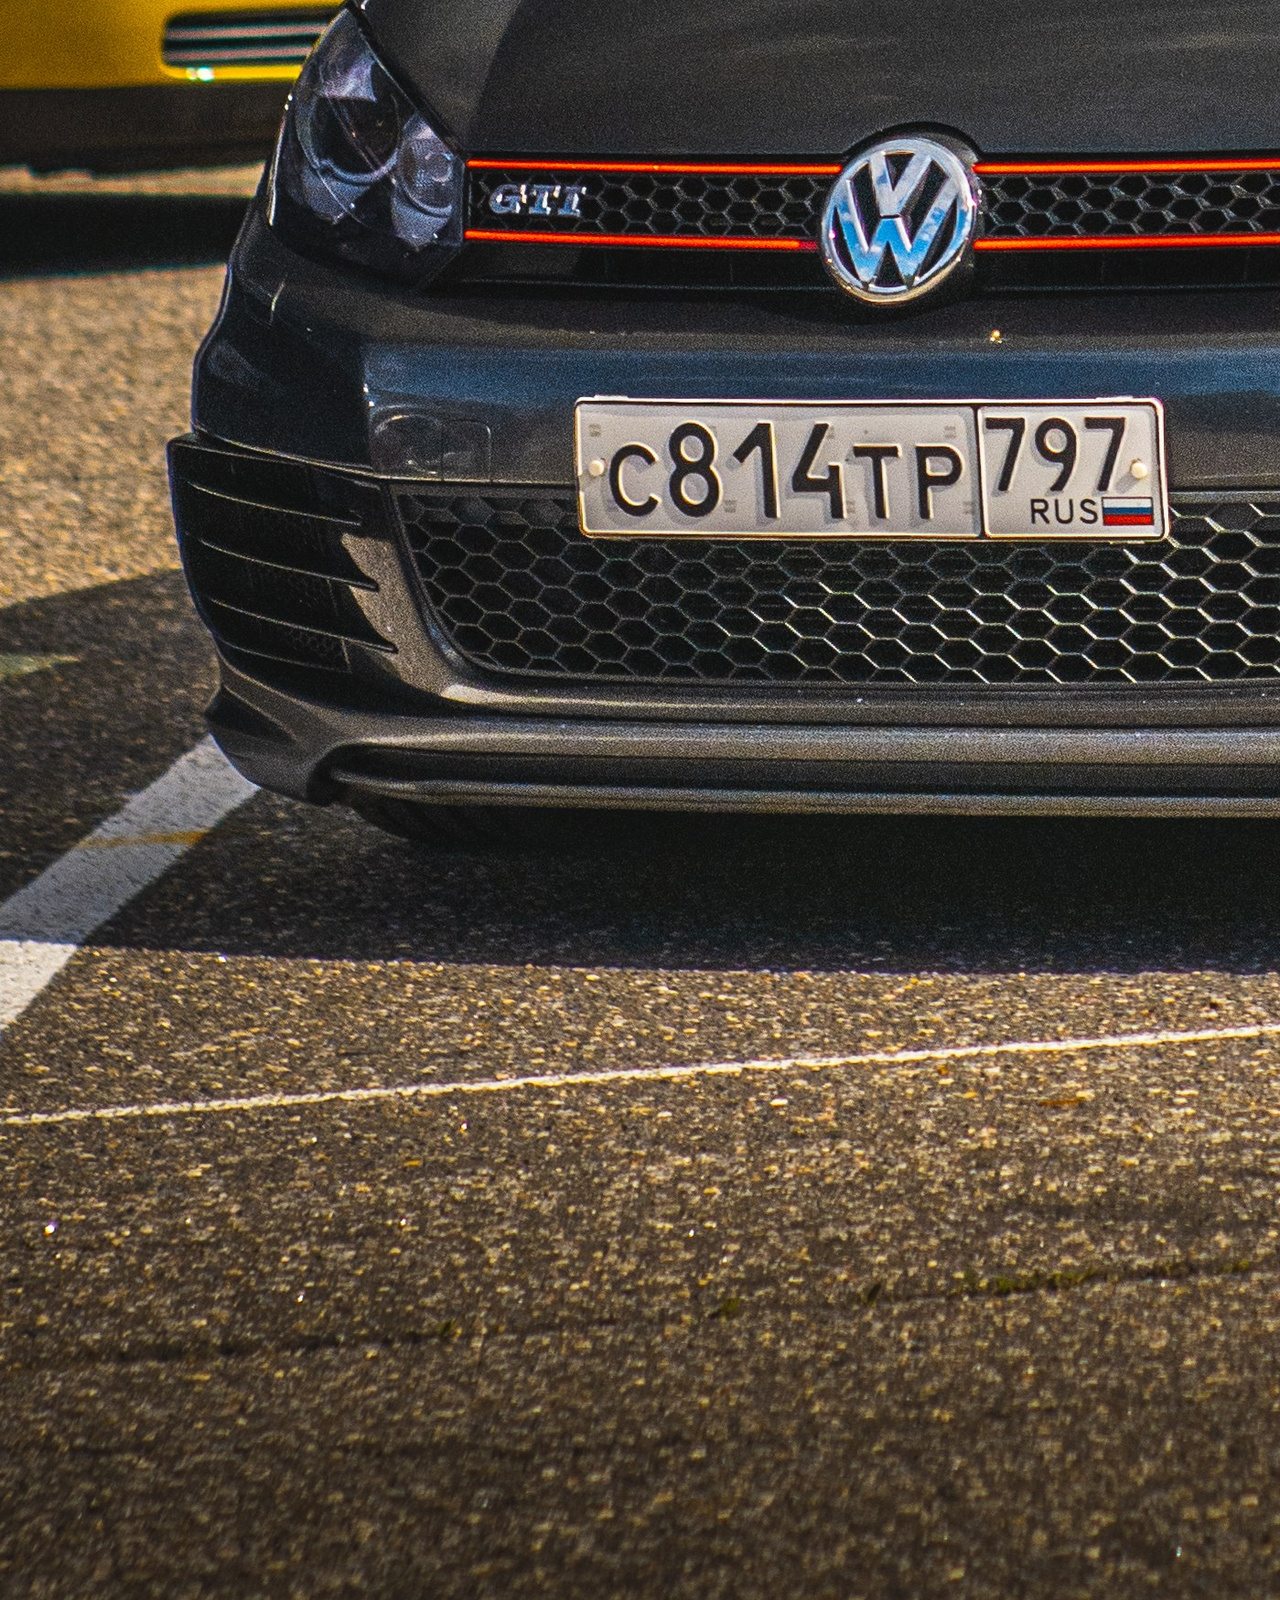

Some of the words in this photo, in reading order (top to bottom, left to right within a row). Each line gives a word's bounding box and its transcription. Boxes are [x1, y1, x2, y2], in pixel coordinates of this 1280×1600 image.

[488, 183, 588, 218] GTI
[822, 140, 976, 300] VW
[985, 416, 1127, 493] 797
[1031, 497, 1099, 526] RUS
